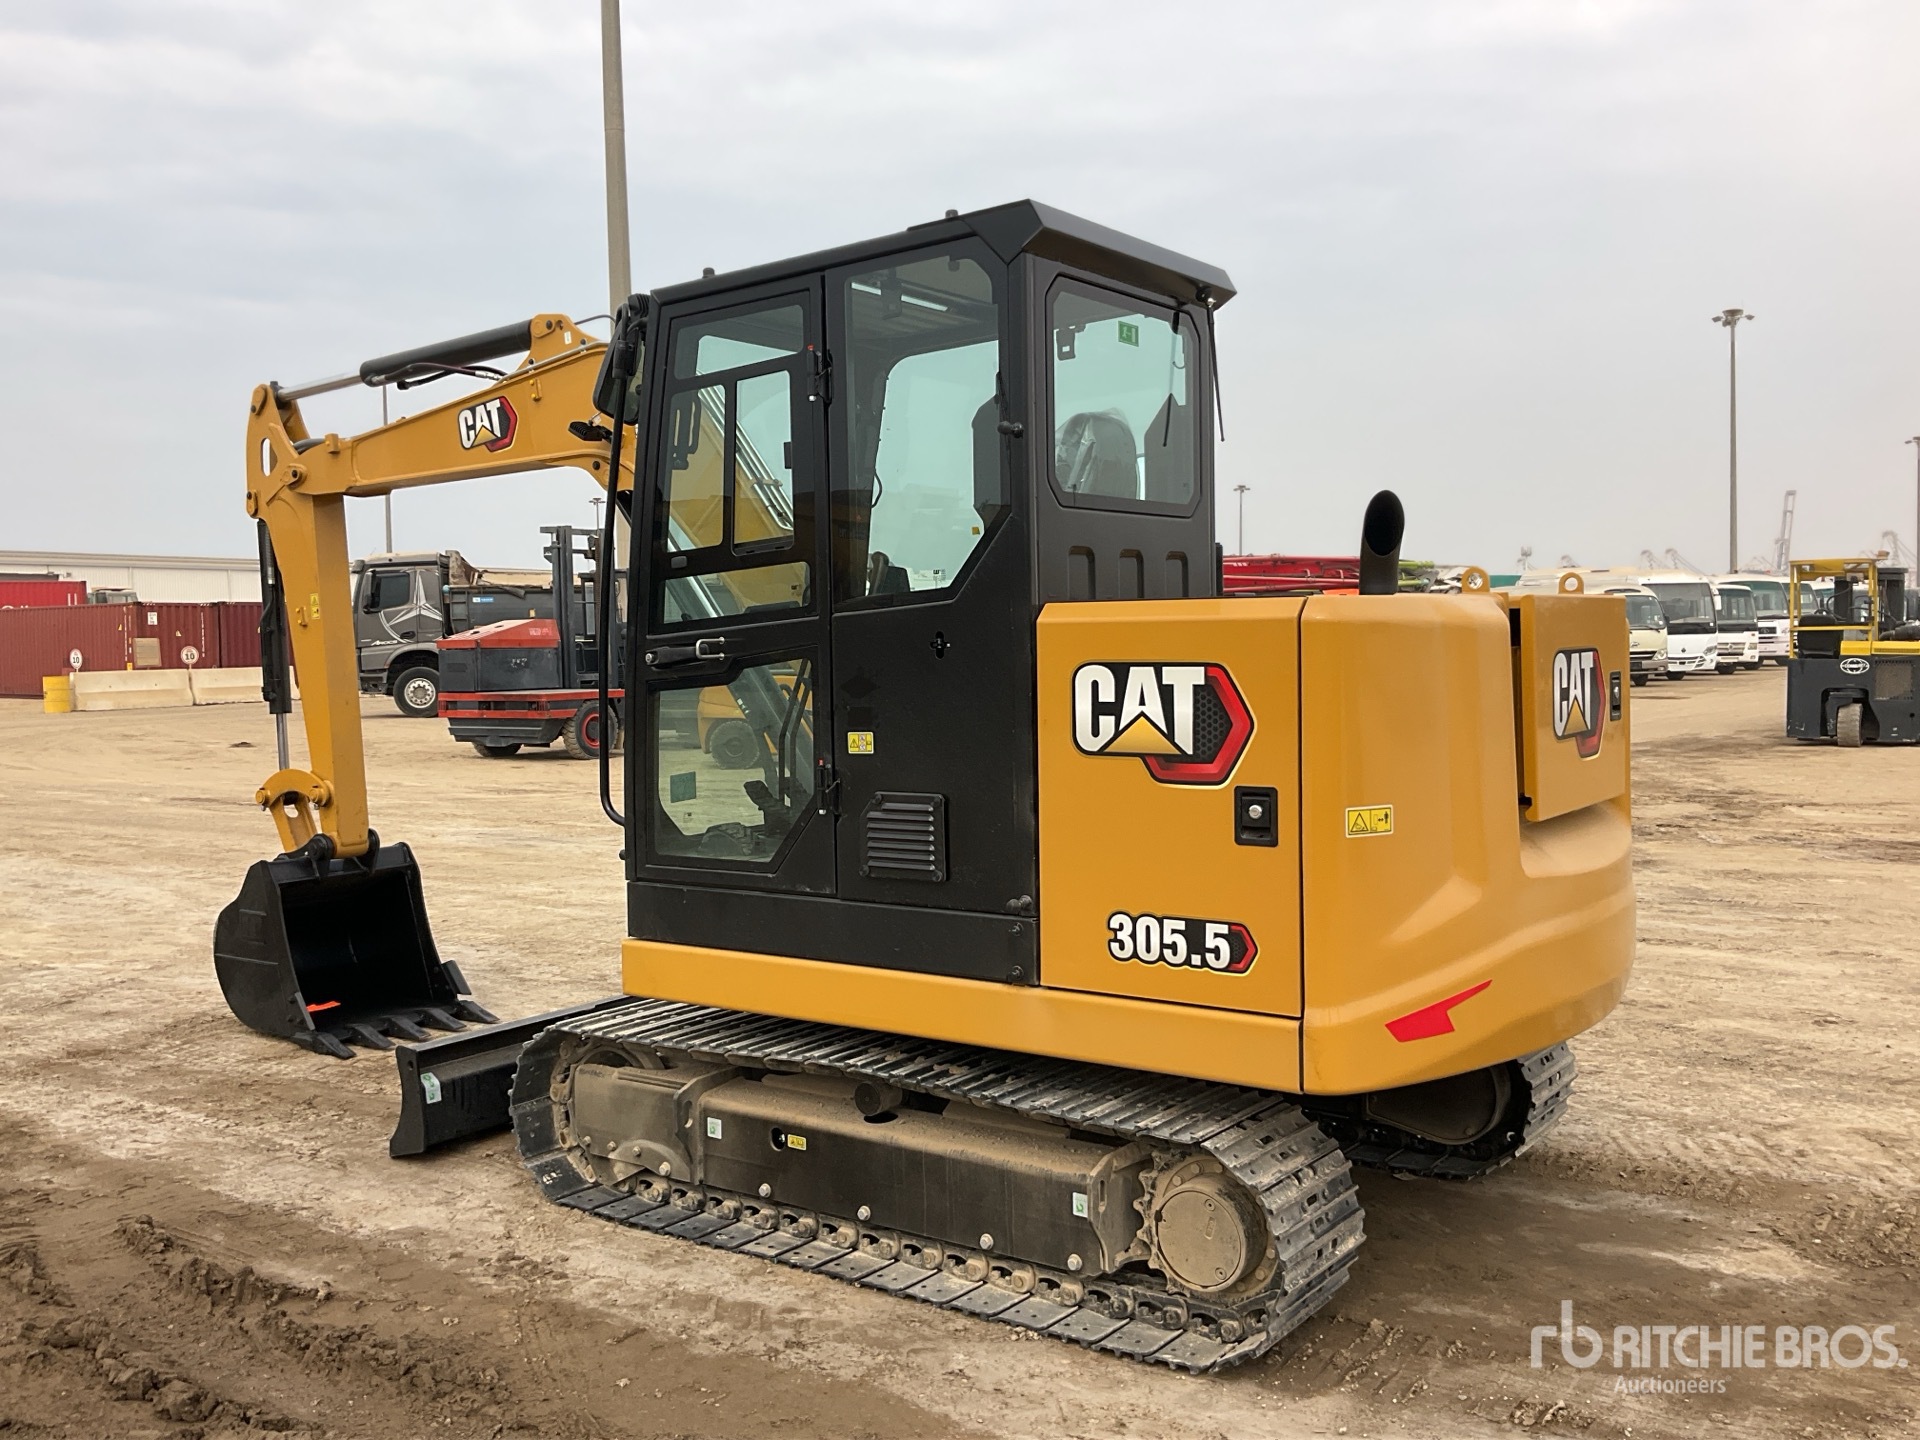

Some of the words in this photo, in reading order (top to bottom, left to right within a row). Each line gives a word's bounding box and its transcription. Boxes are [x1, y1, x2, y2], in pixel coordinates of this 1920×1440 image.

[458, 398, 502, 449] CAT
[72, 656, 80, 664] 10
[184, 652, 196, 661] 10
[1074, 664, 1206, 755] CAT
[1553, 651, 1595, 737] CAT
[1108, 912, 1232, 970] 305.5
